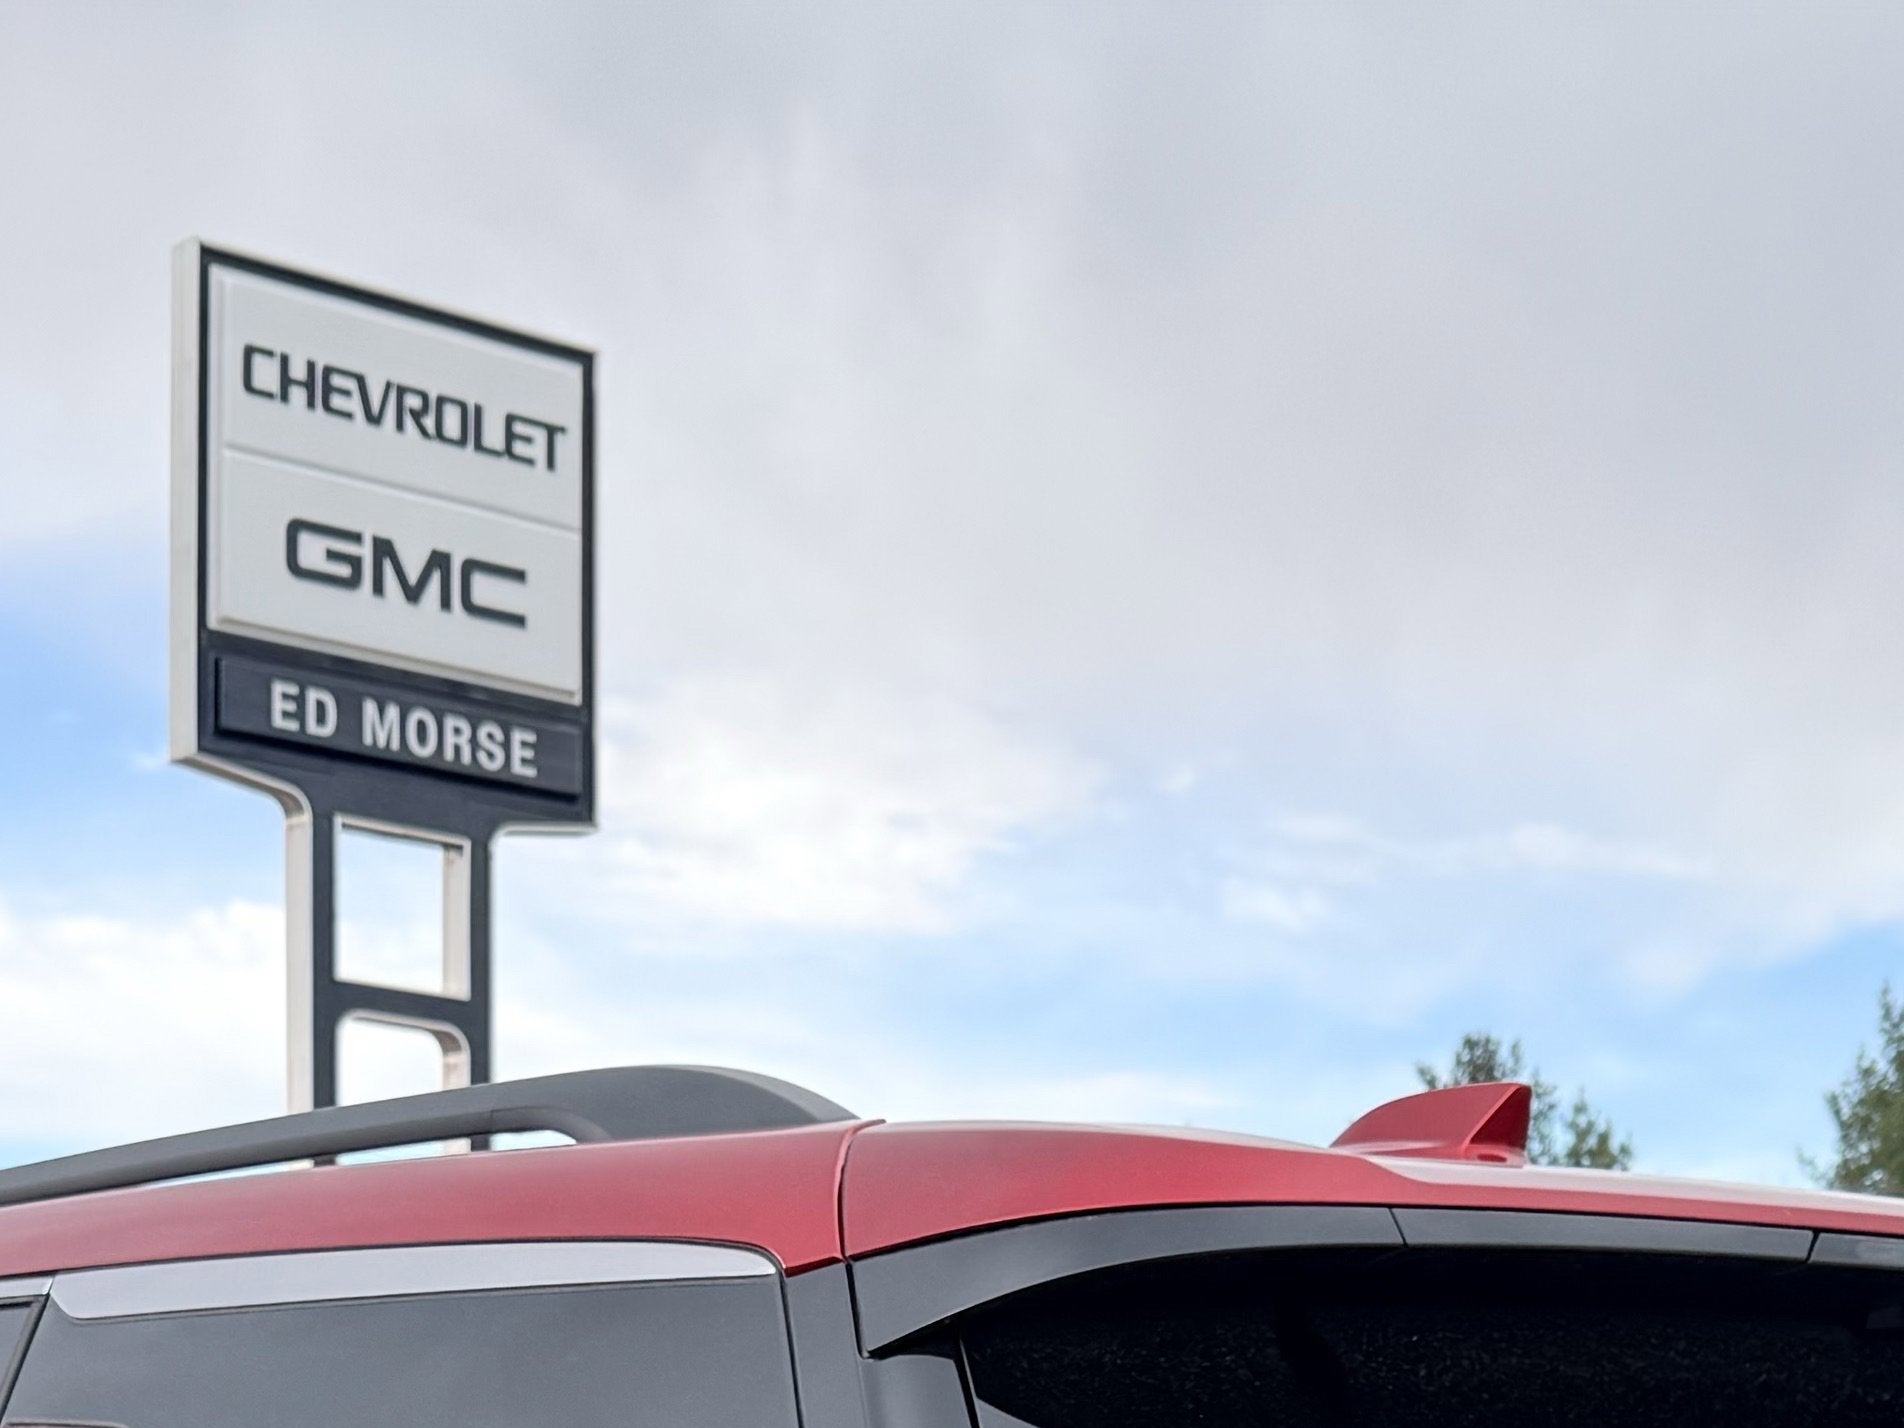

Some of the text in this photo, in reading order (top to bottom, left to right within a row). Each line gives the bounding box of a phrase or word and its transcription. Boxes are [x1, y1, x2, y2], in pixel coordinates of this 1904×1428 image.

[242, 342, 567, 472] CHEVROLET
[285, 516, 528, 630] GMC
[269, 678, 539, 779] ED MORSE
